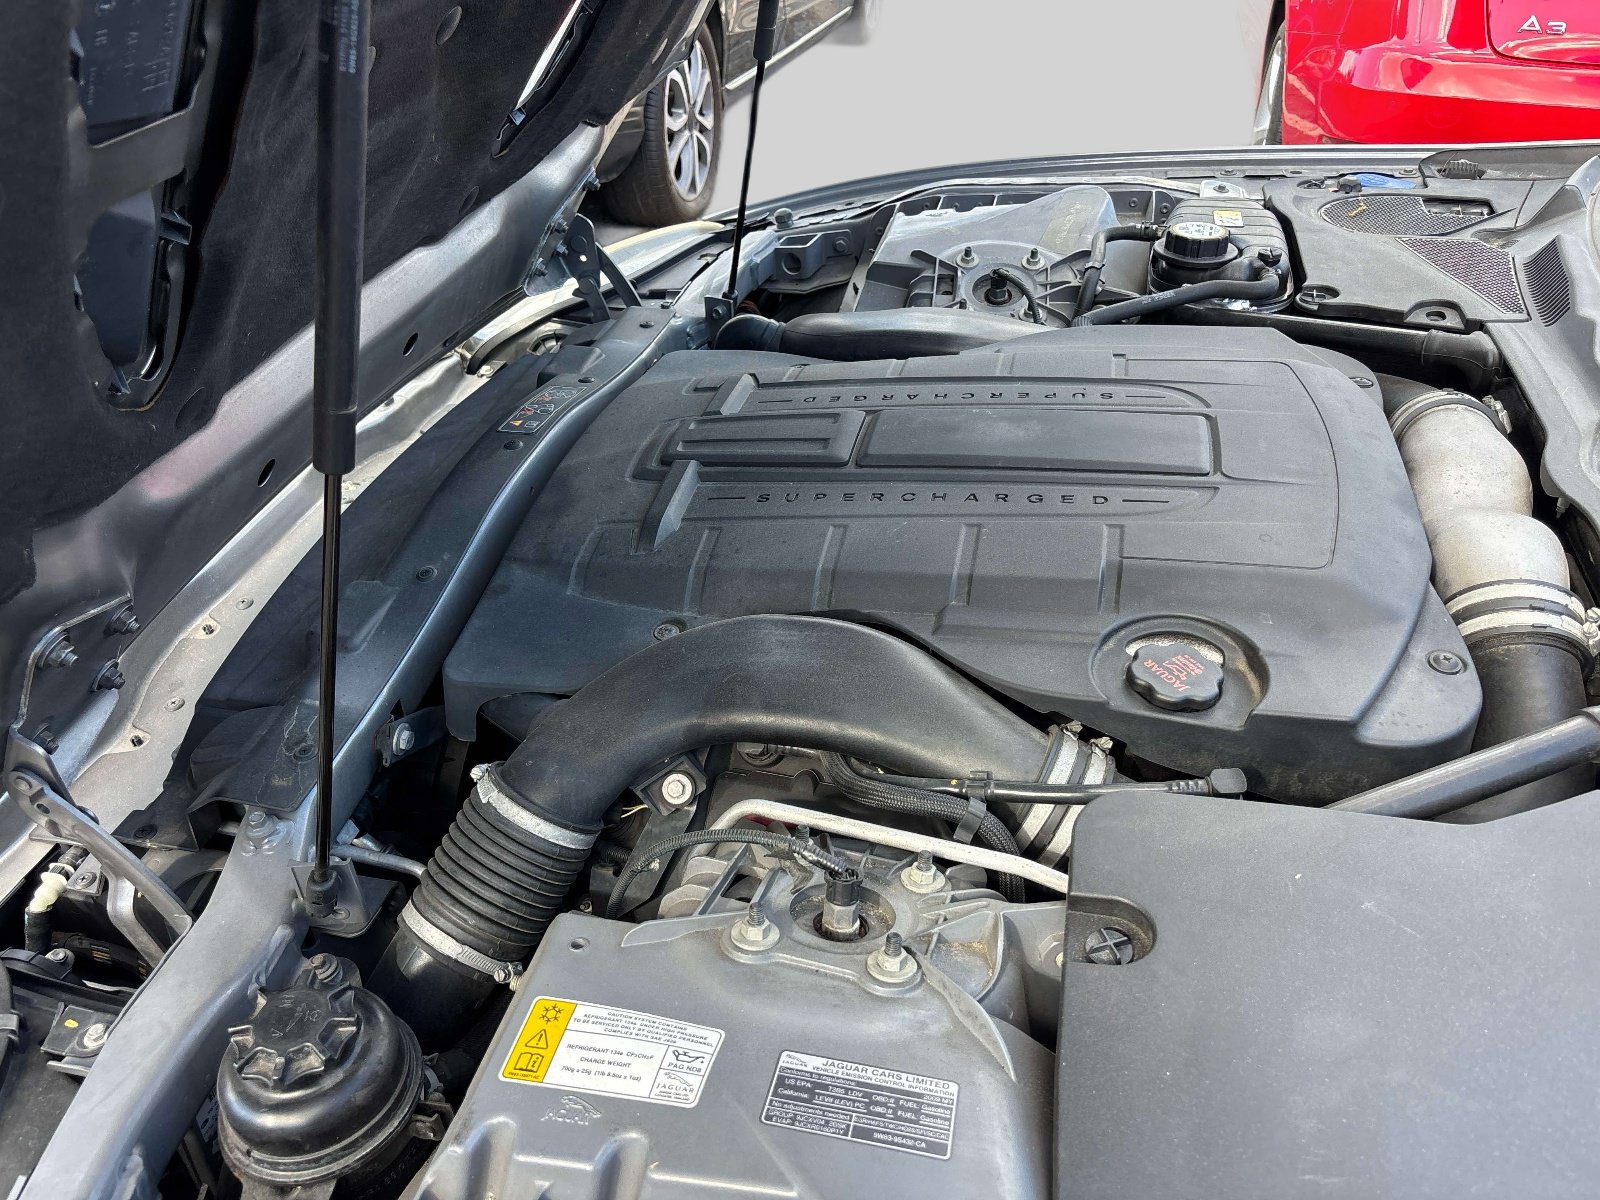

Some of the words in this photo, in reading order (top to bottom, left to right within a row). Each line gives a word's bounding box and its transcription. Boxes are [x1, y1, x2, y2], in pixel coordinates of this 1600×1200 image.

[1517, 14, 1567, 35] A3
[803, 391, 1114, 402] SUPERCHARGED
[756, 492, 1110, 506] SUPERCHARGED
[1143, 659, 1192, 692] JAGUAR
[583, 1013, 623, 1024] REFRIGERANT
[608, 1011, 632, 1020] CAUTION
[634, 1016, 656, 1025] SYSTEM
[658, 1020, 688, 1031] CONTAINS
[591, 1020, 618, 1028] SERVICED
[646, 1028, 678, 1038] QUALIFIED
[604, 1028, 633, 1036] COMPLIES
[566, 1043, 610, 1054] REFRIGERANT
[580, 1056, 606, 1064] CHARGE
[780, 1066, 811, 1077] Conforms
[822, 1060, 869, 1074] JAGUAR
[871, 1069, 902, 1081] CARS
[906, 1075, 950, 1089] LIMITED
[812, 1066, 839, 1075] VEHICLE
[841, 1071, 872, 1081] EMISSION
[874, 1077, 905, 1087] CONTROL
[908, 1084, 955, 1097] INFORMATION
[656, 1083, 694, 1093] JAGUAR
[923, 1094, 940, 1102] 2009
[783, 1103, 823, 1115] adjustments
[824, 1112, 850, 1120] needed
[921, 1104, 951, 1114] Gasoline
[920, 1114, 949, 1126] Gasoline
